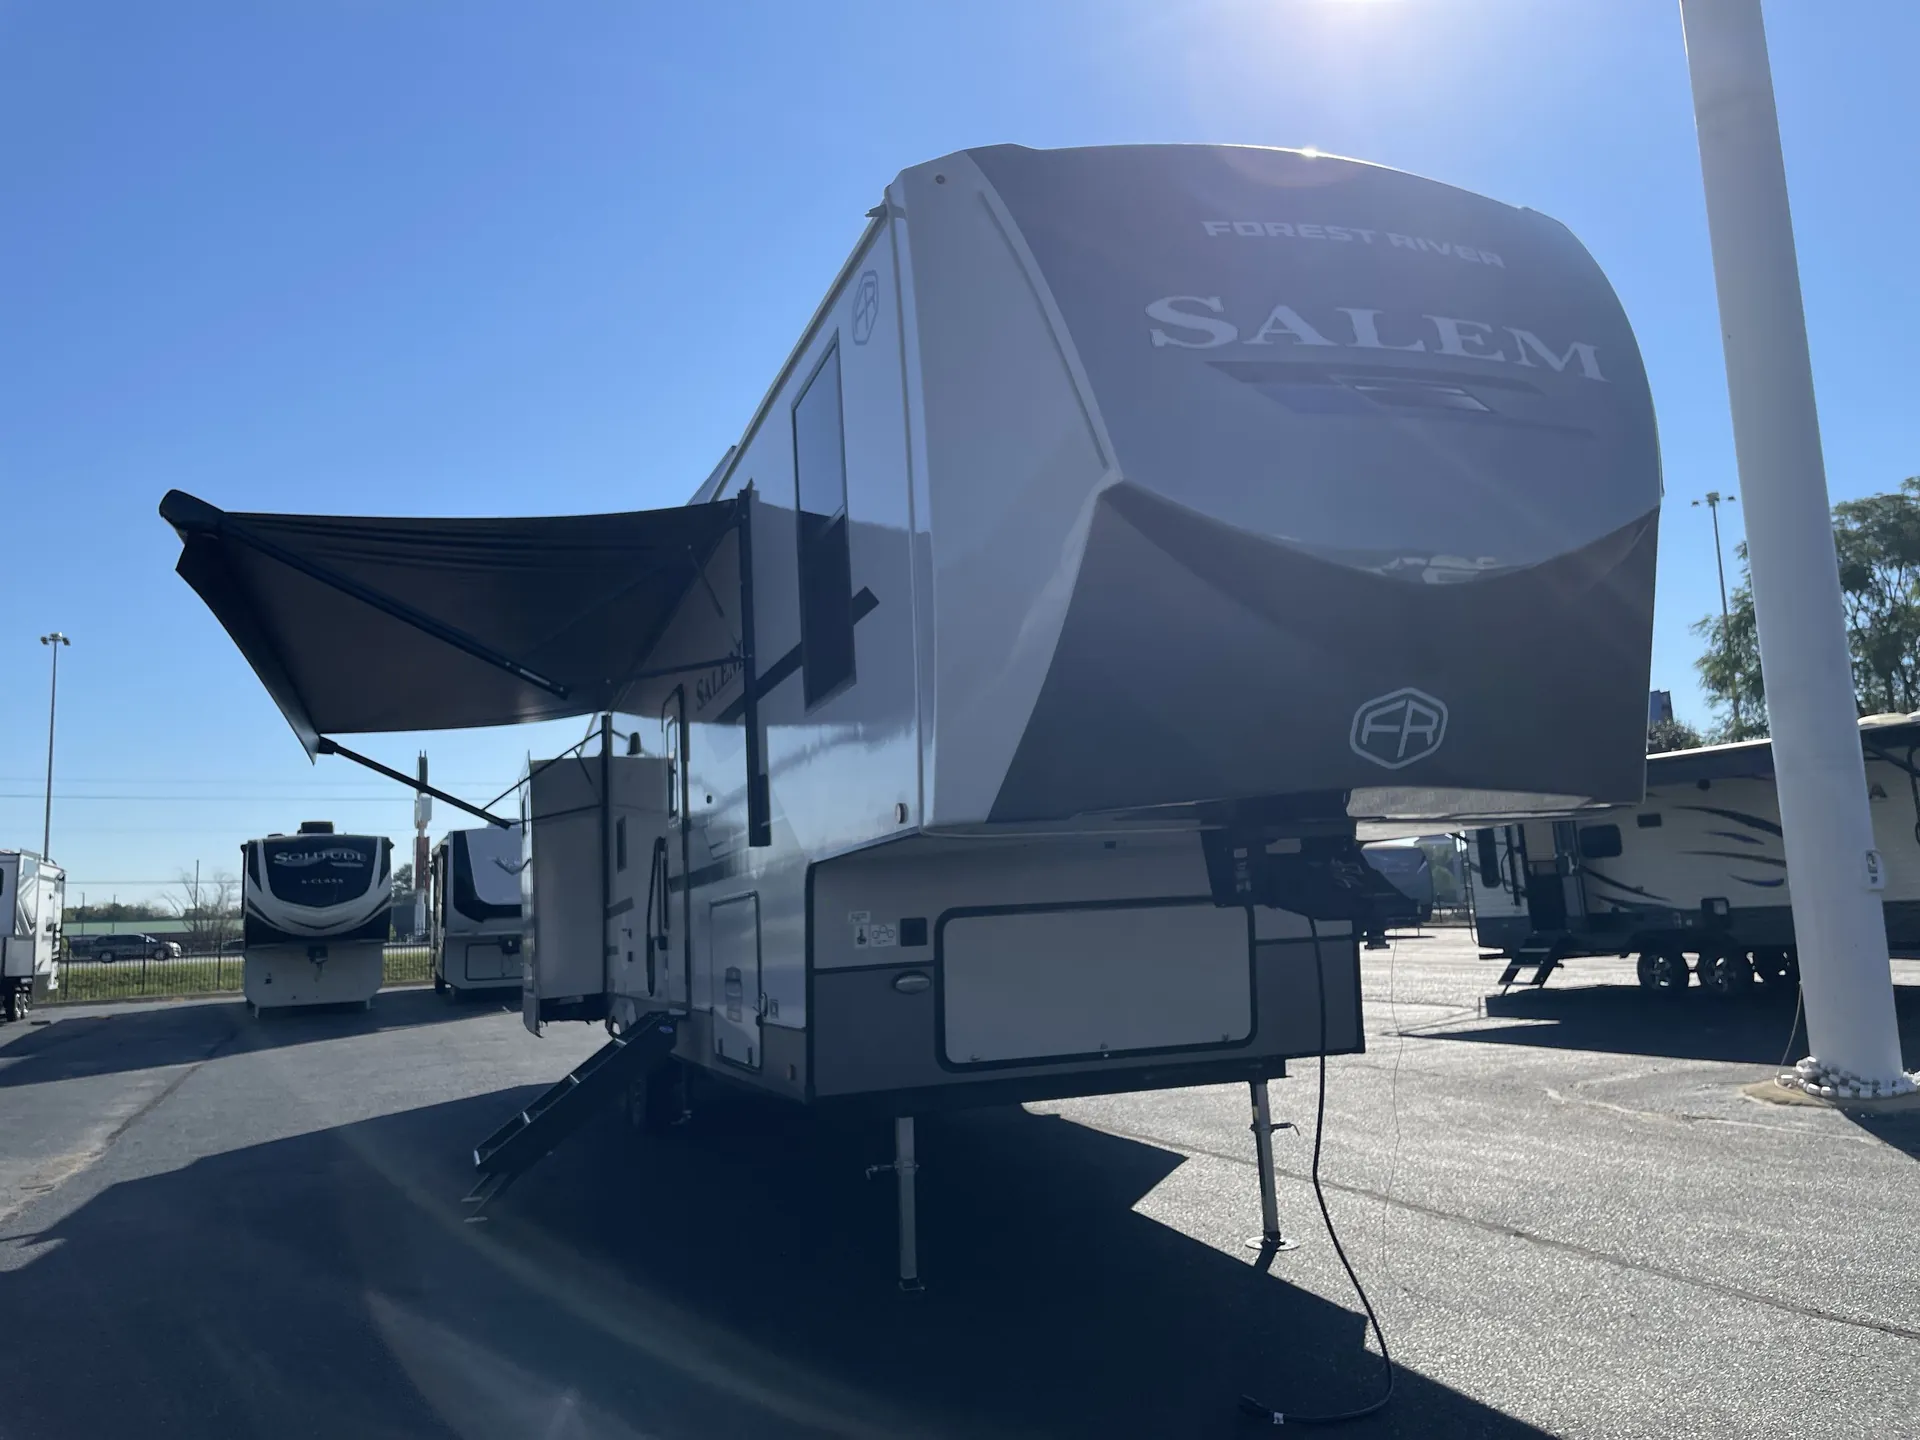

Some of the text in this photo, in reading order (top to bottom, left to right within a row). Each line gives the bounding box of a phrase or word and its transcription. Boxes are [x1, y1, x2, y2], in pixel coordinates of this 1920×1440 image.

[1203, 221, 1505, 268] FOREST RIVER
[1145, 296, 1611, 383] SALEM
[274, 852, 367, 864] SOLITUDE
